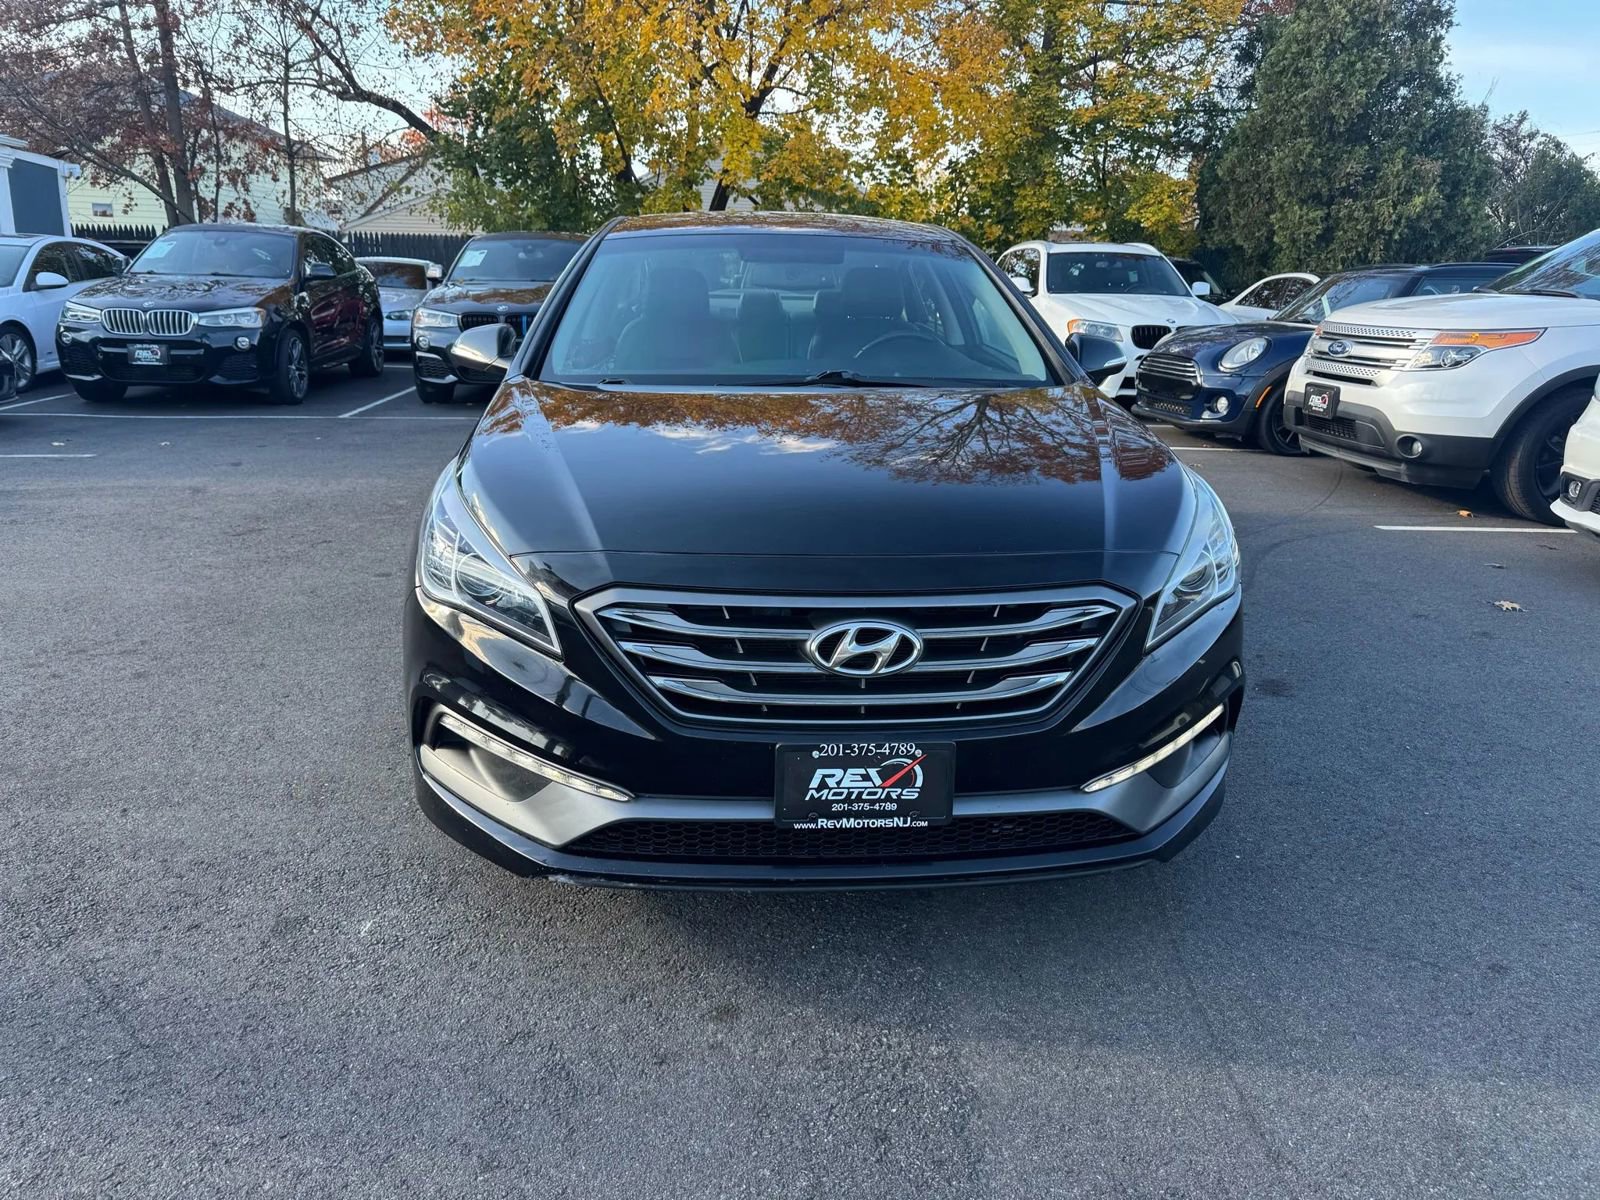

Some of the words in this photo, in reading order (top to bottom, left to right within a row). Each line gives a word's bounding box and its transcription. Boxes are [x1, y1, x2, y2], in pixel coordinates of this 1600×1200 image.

[819, 743, 916, 756] 201-375-4789
[805, 788, 921, 800] MOTORS
[831, 803, 897, 811] 201-375-4789
